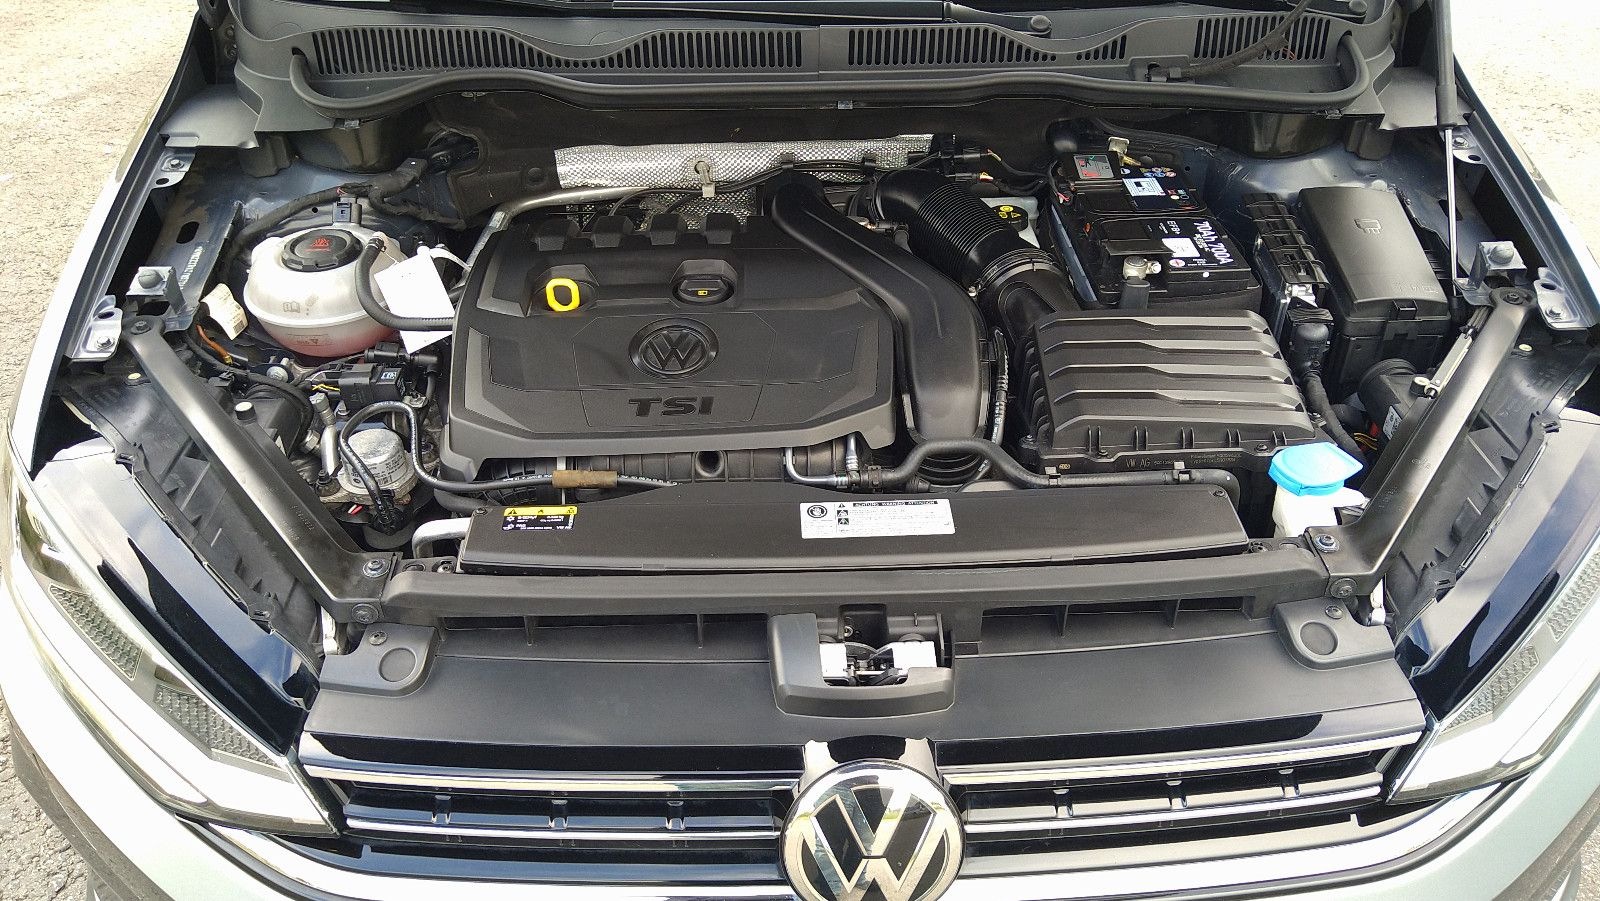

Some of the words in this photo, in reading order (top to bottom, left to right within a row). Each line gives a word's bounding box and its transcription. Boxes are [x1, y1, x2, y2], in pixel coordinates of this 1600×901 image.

[1193, 221, 1218, 242] 70Ah
[1208, 242, 1235, 265] 700A
[640, 328, 708, 373] VW
[628, 396, 715, 417] TSI
[792, 772, 954, 901] VW
